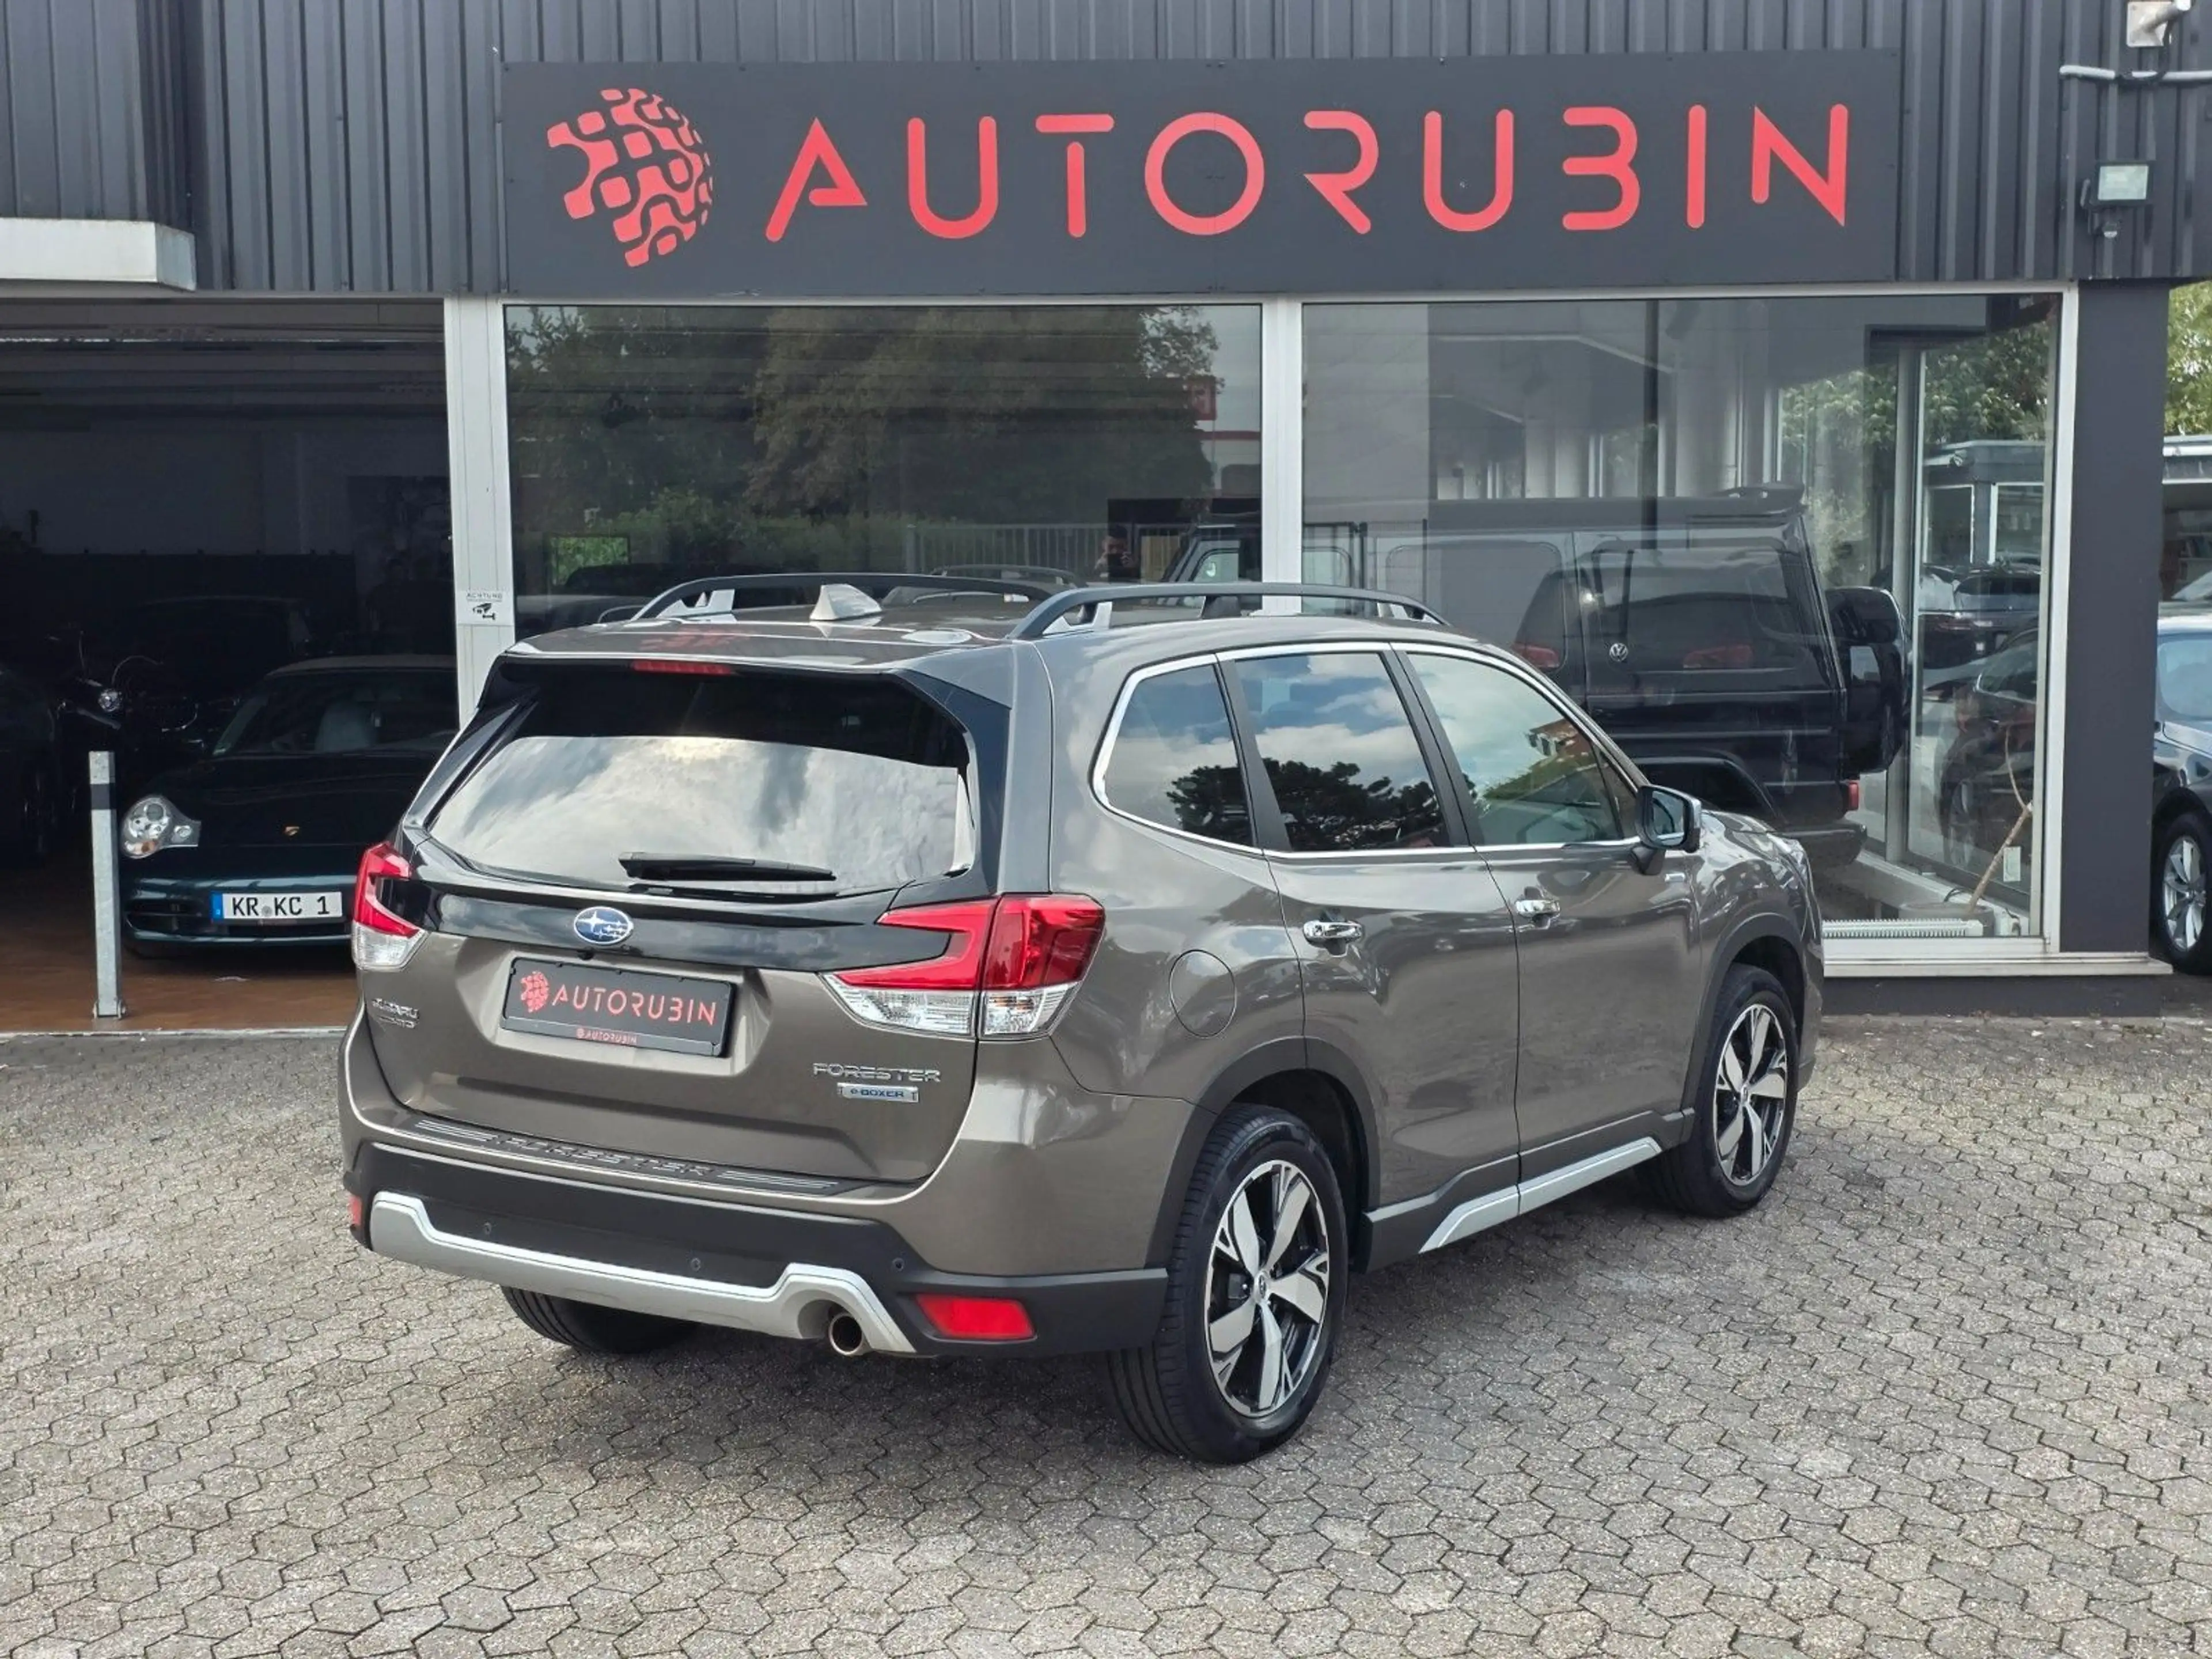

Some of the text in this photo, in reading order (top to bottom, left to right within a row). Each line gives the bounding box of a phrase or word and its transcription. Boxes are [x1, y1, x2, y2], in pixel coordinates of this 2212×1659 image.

[765, 104, 1849, 243] AUTORUBIN
[232, 896, 330, 916] KR KC 1
[551, 983, 717, 1026] AUTORUBIN
[585, 1029, 637, 1046] AUTORUBIN
[812, 1063, 941, 1082] FORESTER
[850, 1088, 904, 1098] e-BOXER
